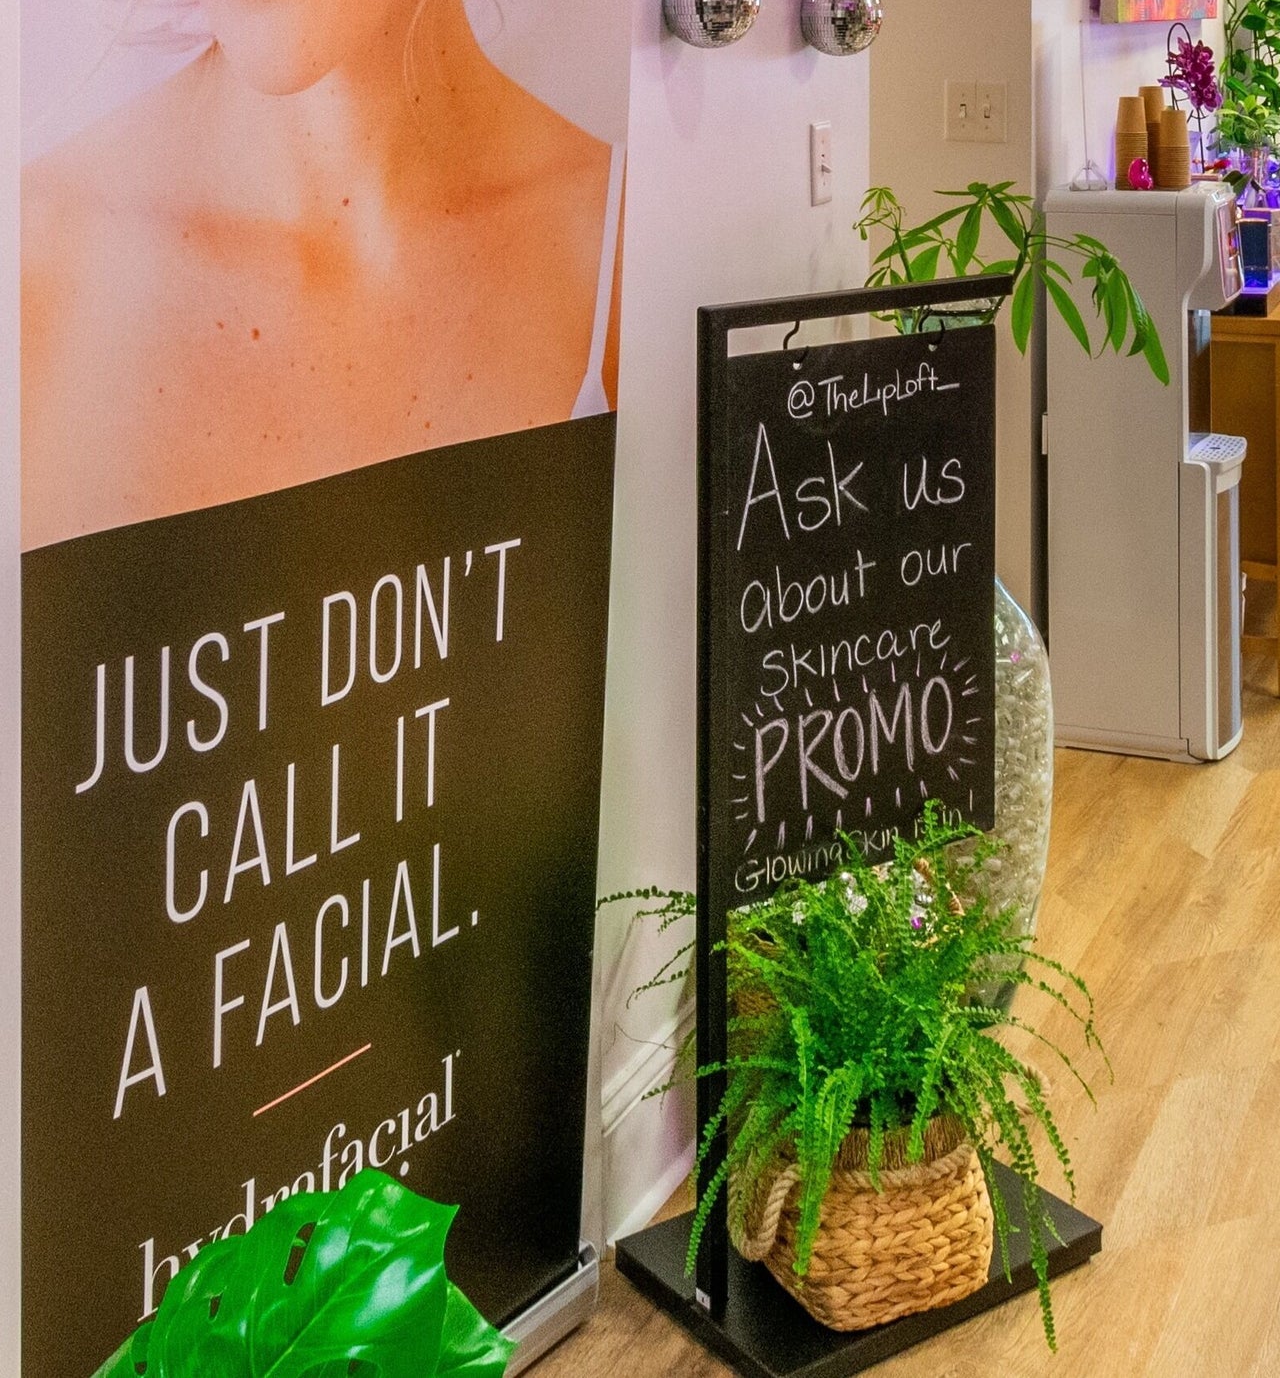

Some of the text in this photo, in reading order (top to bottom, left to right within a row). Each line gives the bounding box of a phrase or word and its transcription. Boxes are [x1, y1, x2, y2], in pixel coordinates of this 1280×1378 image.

[737, 422, 965, 551] Ask us
[740, 542, 972, 633] about our
[75, 538, 521, 794] JUST DON'T
[754, 676, 953, 823] PROMO
[165, 697, 450, 923] CALL IT
[113, 843, 479, 1119] A FACIAL.
[137, 1051, 458, 1322] hdrfacial
